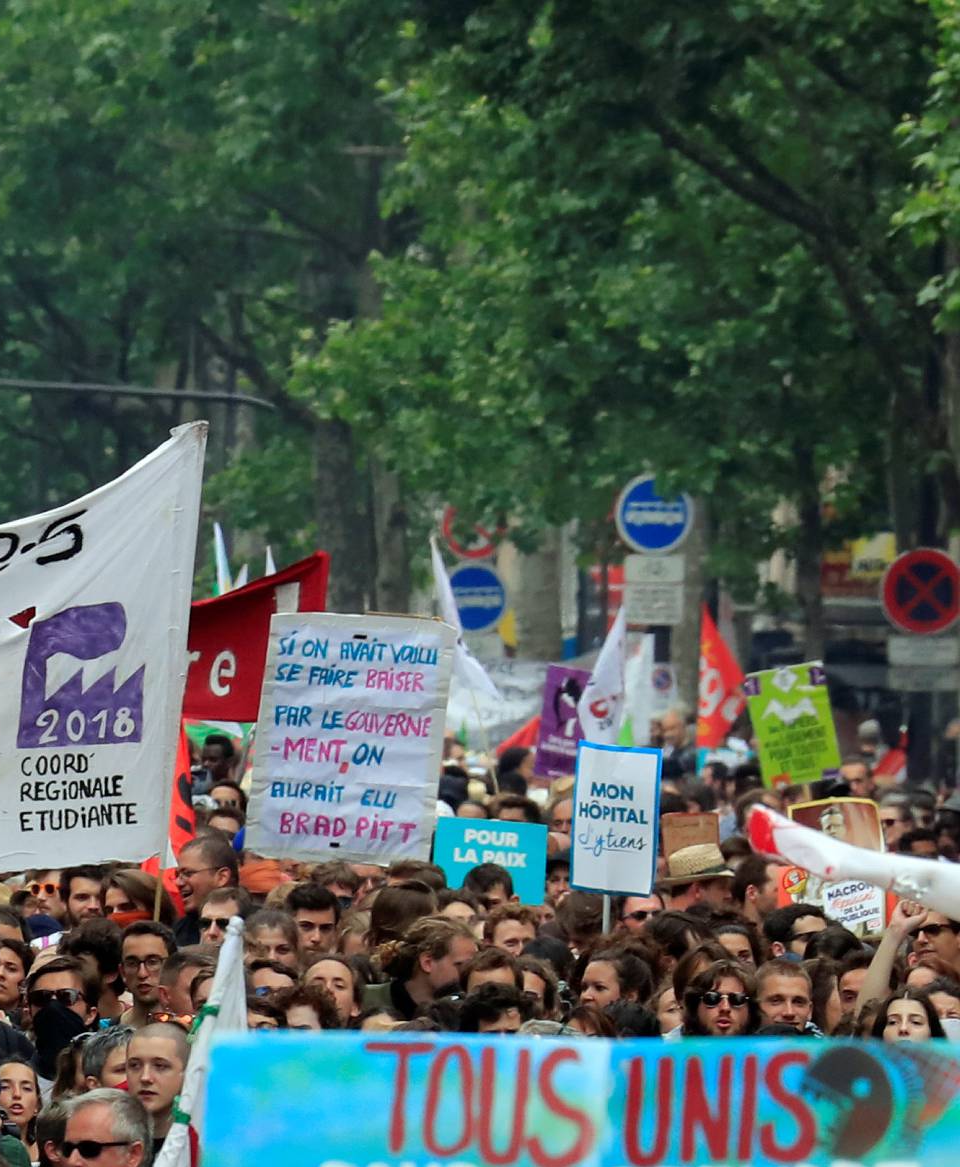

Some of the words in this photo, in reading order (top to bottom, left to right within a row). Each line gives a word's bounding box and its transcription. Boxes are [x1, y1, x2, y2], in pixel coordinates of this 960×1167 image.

[301, 638, 329, 660] ON
[390, 642, 438, 666] VOULU
[274, 663, 304, 682] SE
[35, 707, 136, 745] 2018
[274, 704, 313, 728] PAR
[320, 711, 345, 730] LE
[344, 709, 432, 738] GOUVERNE
[351, 743, 386, 766] ON
[360, 788, 398, 809] ELU
[590, 781, 635, 801] MON
[279, 811, 347, 838] BRAD
[578, 800, 649, 826] HÔPITAL
[463, 828, 520, 848] POUR
[606, 827, 648, 851] tiens
[453, 847, 479, 864] LA
[482, 850, 528, 868] PAIX
[622, 1049, 818, 1167] UNIS
